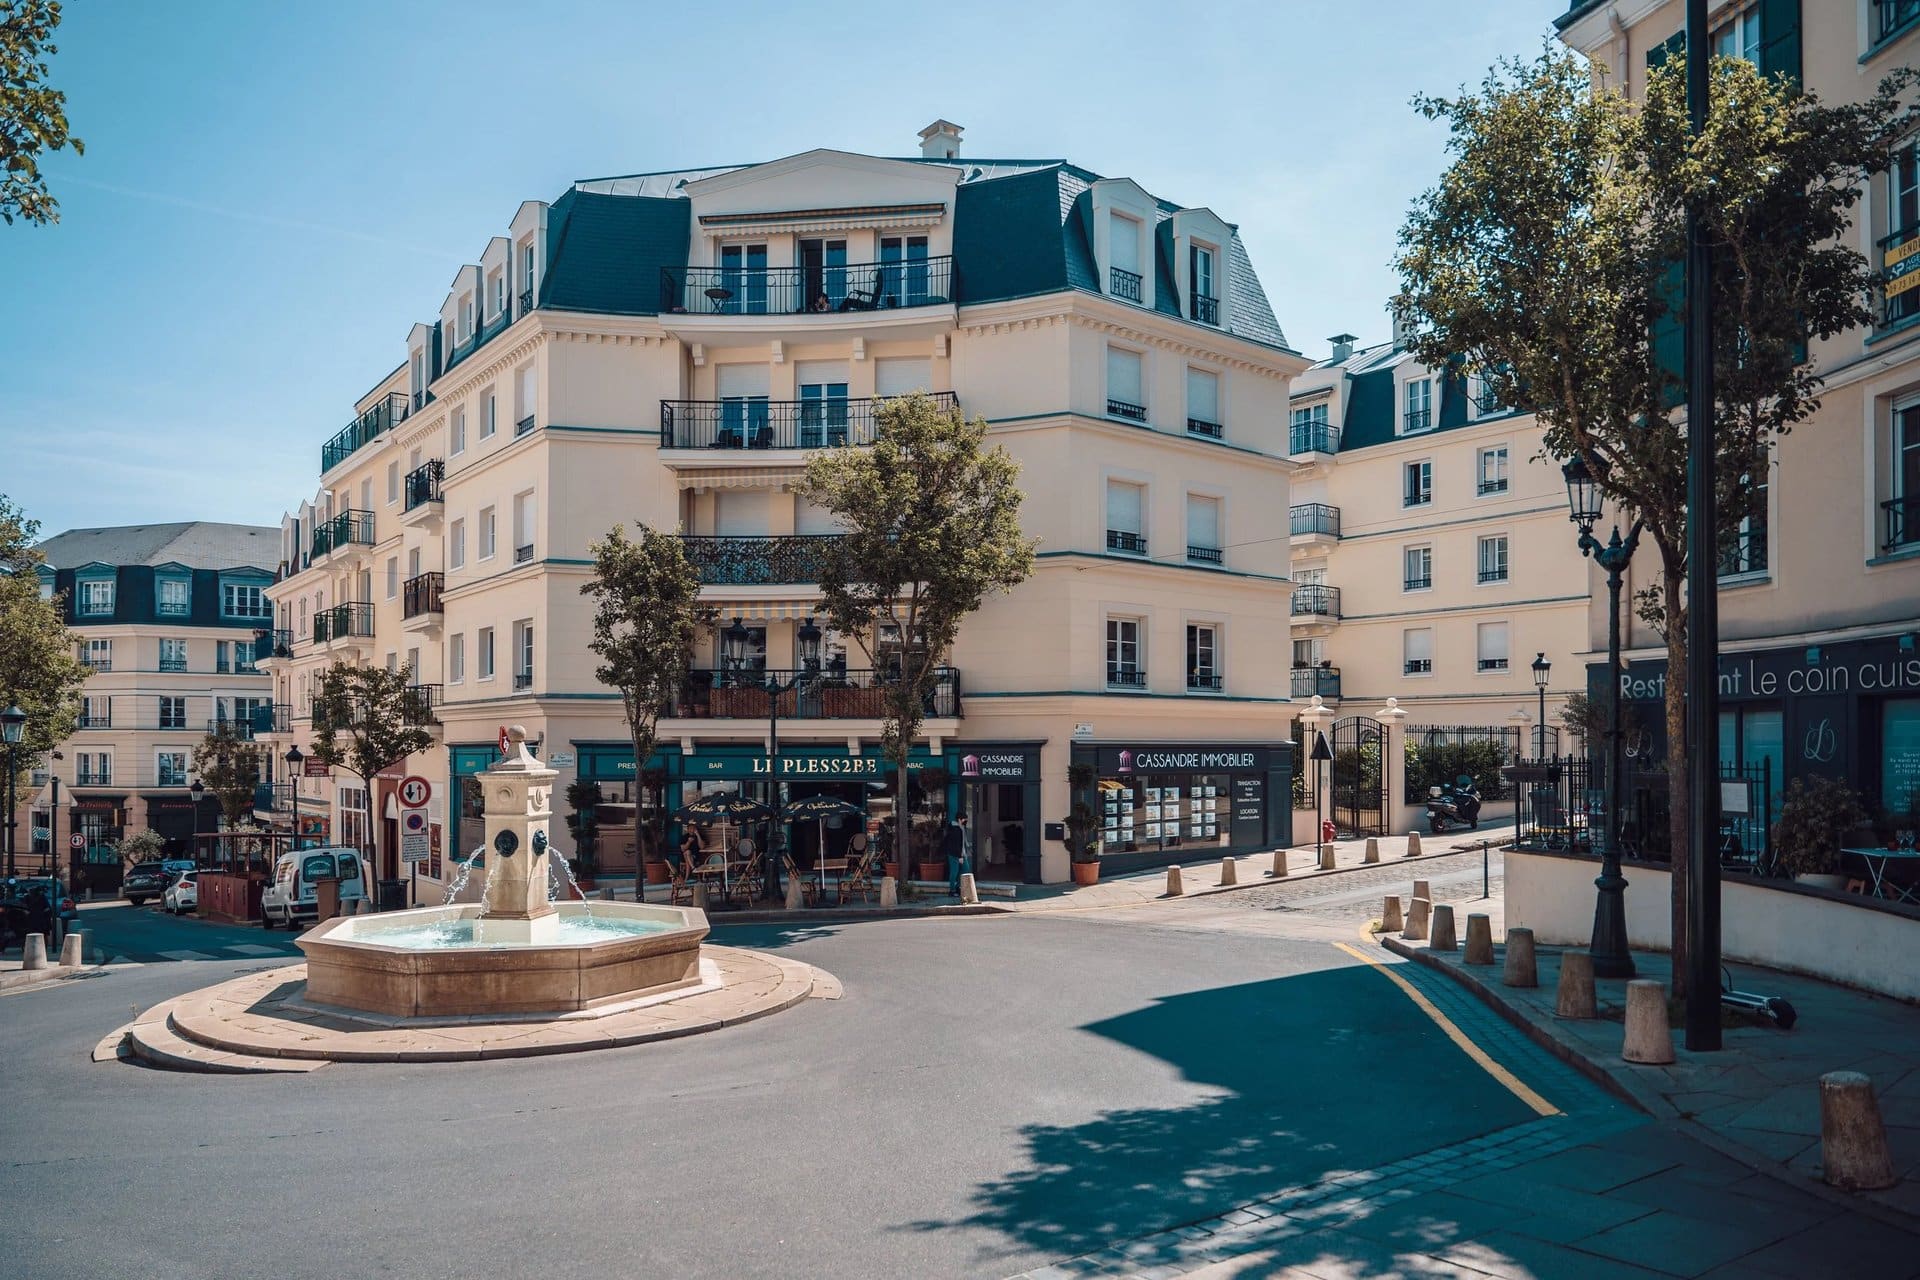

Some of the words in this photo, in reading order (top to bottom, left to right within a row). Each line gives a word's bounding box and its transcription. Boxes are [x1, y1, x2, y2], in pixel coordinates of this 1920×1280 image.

[1898, 239, 1920, 257] VEND
[1750, 659, 1777, 695] le
[1787, 655, 1849, 694] coin
[1859, 648, 1920, 689] cuis
[1620, 667, 1742, 699] Restnt
[980, 755, 1024, 763] CASSANDRE
[1136, 753, 1199, 768] CASSANDRE
[1201, 753, 1255, 767] IMMOBILIER
[982, 767, 1023, 776] IMMOBILIER
